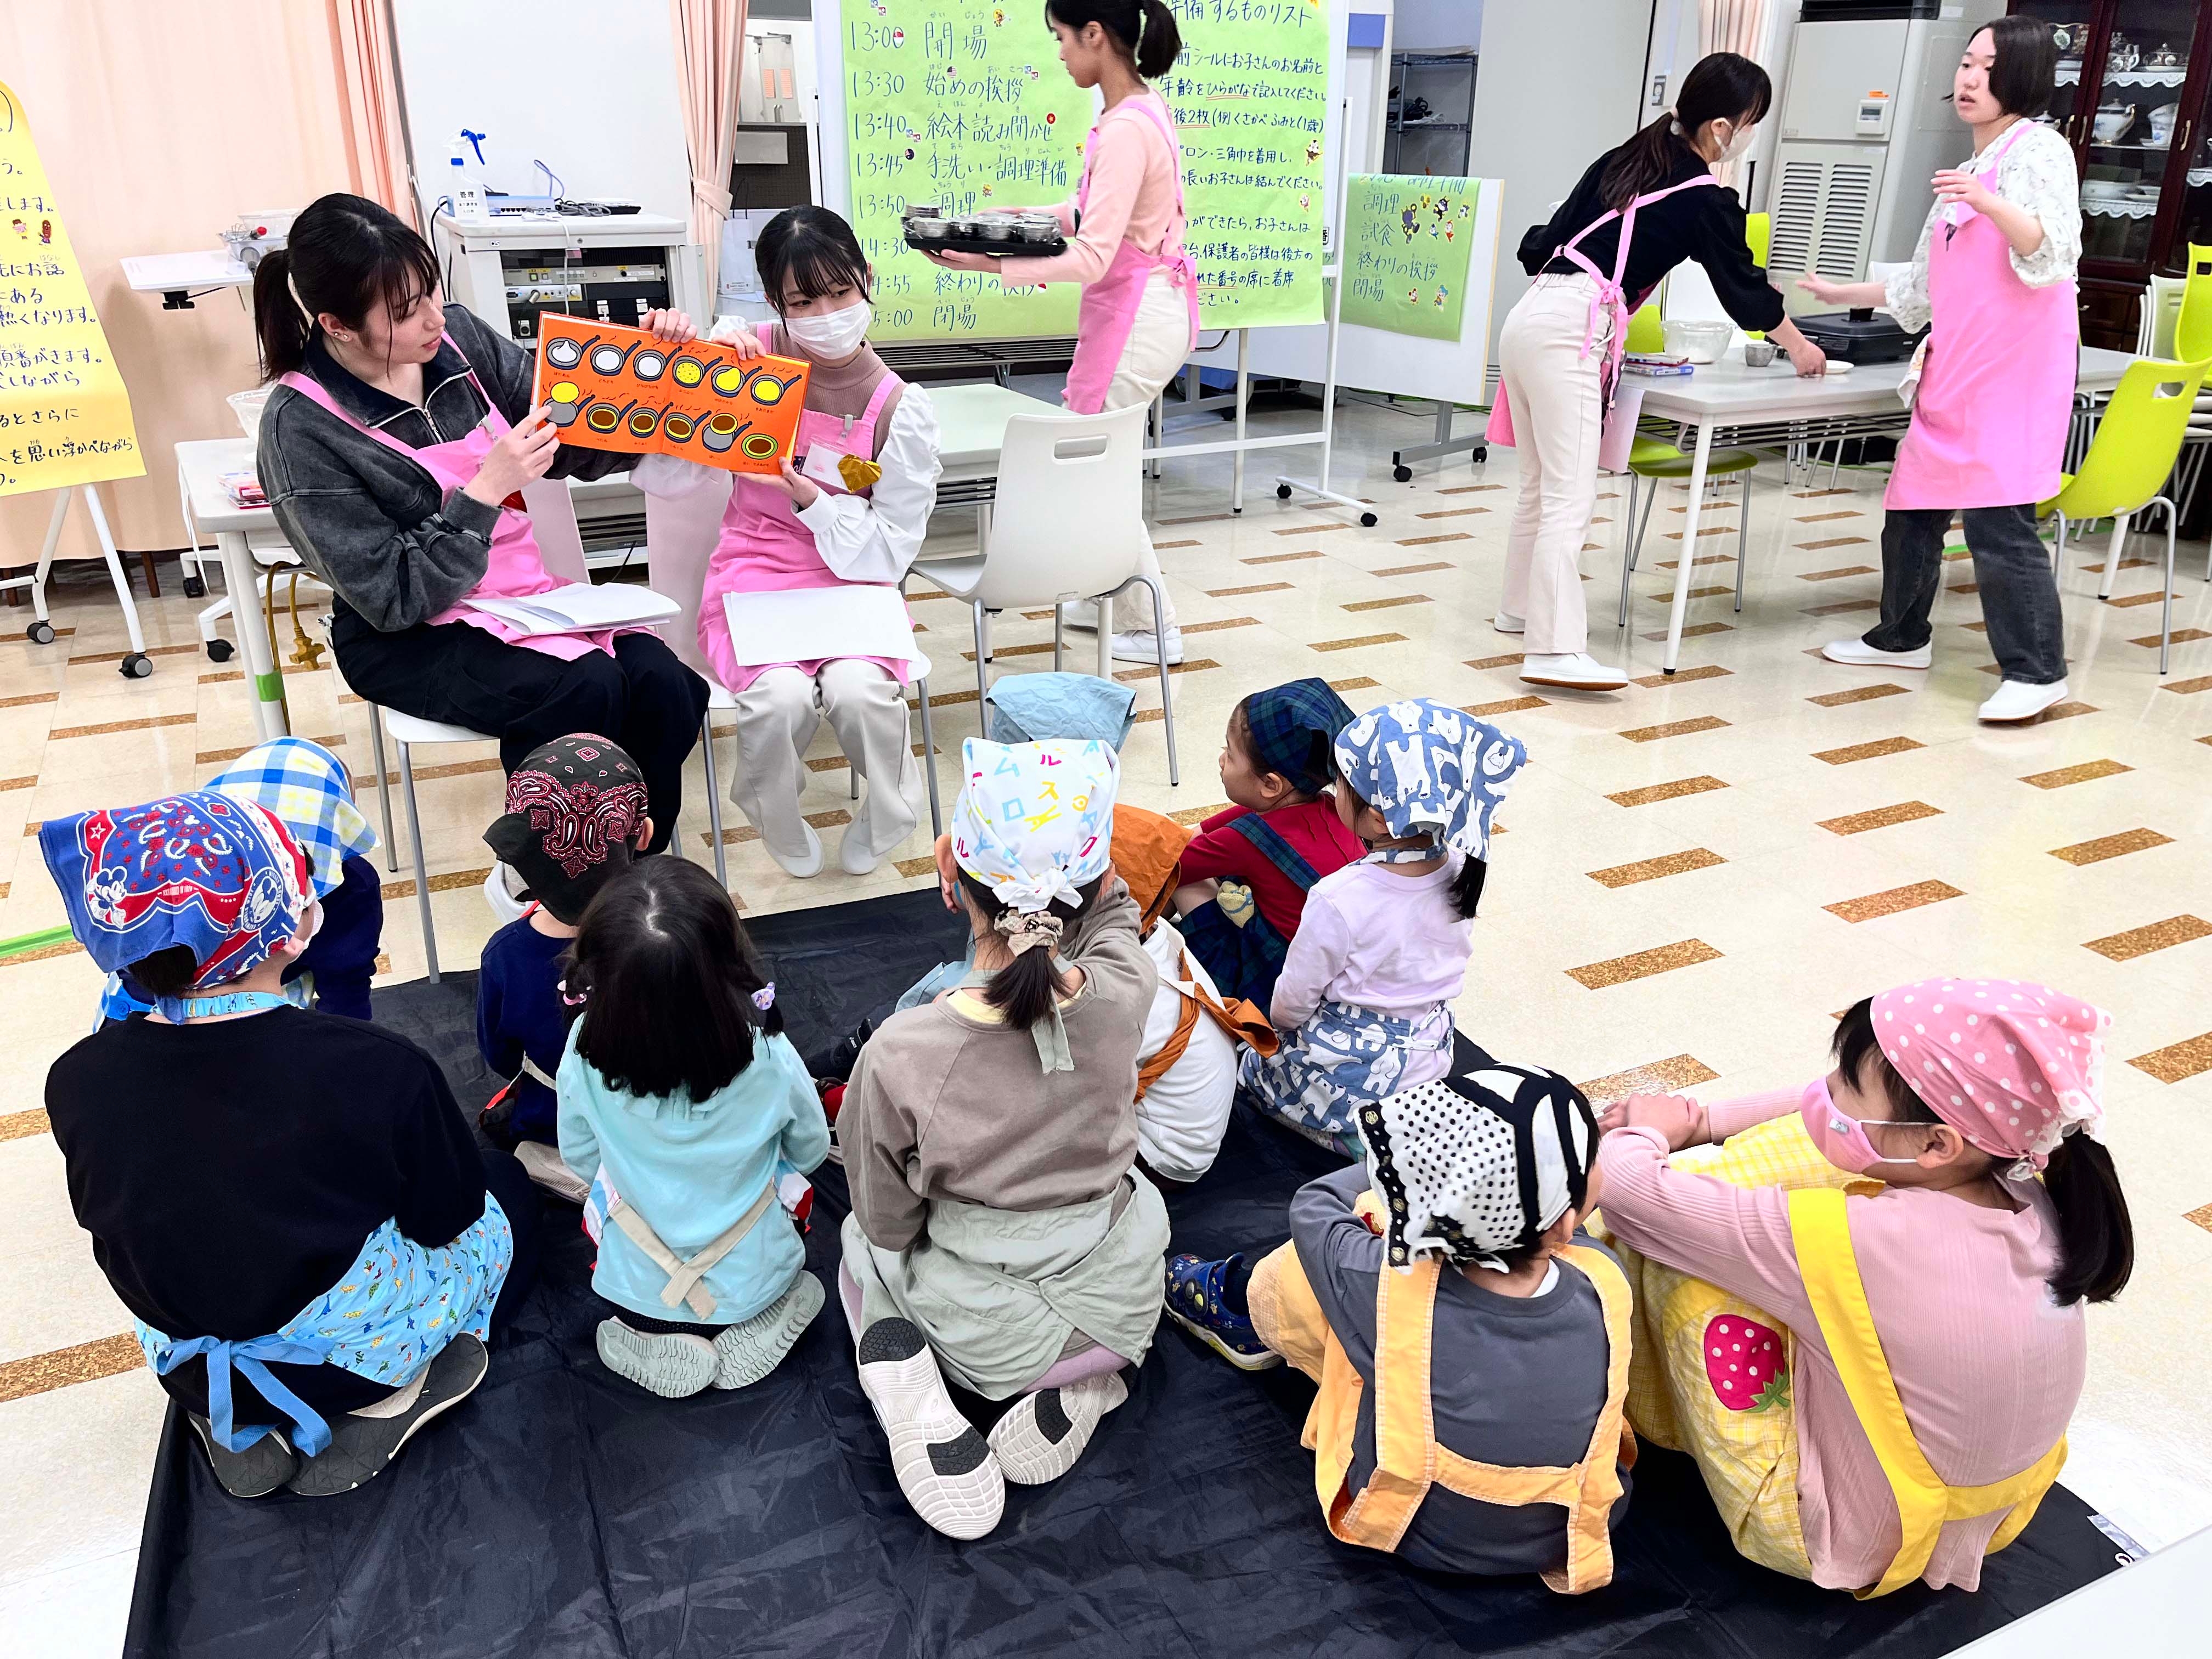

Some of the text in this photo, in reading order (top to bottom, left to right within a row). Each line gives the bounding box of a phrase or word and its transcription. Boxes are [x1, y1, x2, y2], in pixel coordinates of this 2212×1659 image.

[851, 21, 987, 60] 13:00 開場
[1177, 42, 1324, 75] 前シールにお子さんのお名前と
[853, 71, 1024, 104] 13:30 始めの挨拶
[855, 112, 907, 140] 13:40
[856, 153, 904, 177] 13:45
[1180, 145, 1292, 163] ロン・三角巾を着用し、
[0, 197, 54, 213] します。
[859, 187, 976, 219] 13:50 調理
[1363, 190, 1401, 216] 調理
[1184, 215, 1311, 233] ができたら、お子さんは
[1359, 221, 1396, 247] 試食
[861, 237, 909, 258] 14:30
[1356, 250, 1440, 282] 終わりの挨拶
[872, 270, 1035, 297] 4:55 終わりの
[1353, 277, 1385, 303] 閉場
[874, 303, 977, 331] 5:00 閉場
[0, 370, 80, 390] しながら
[0, 437, 133, 465] を思い浮かべながら
